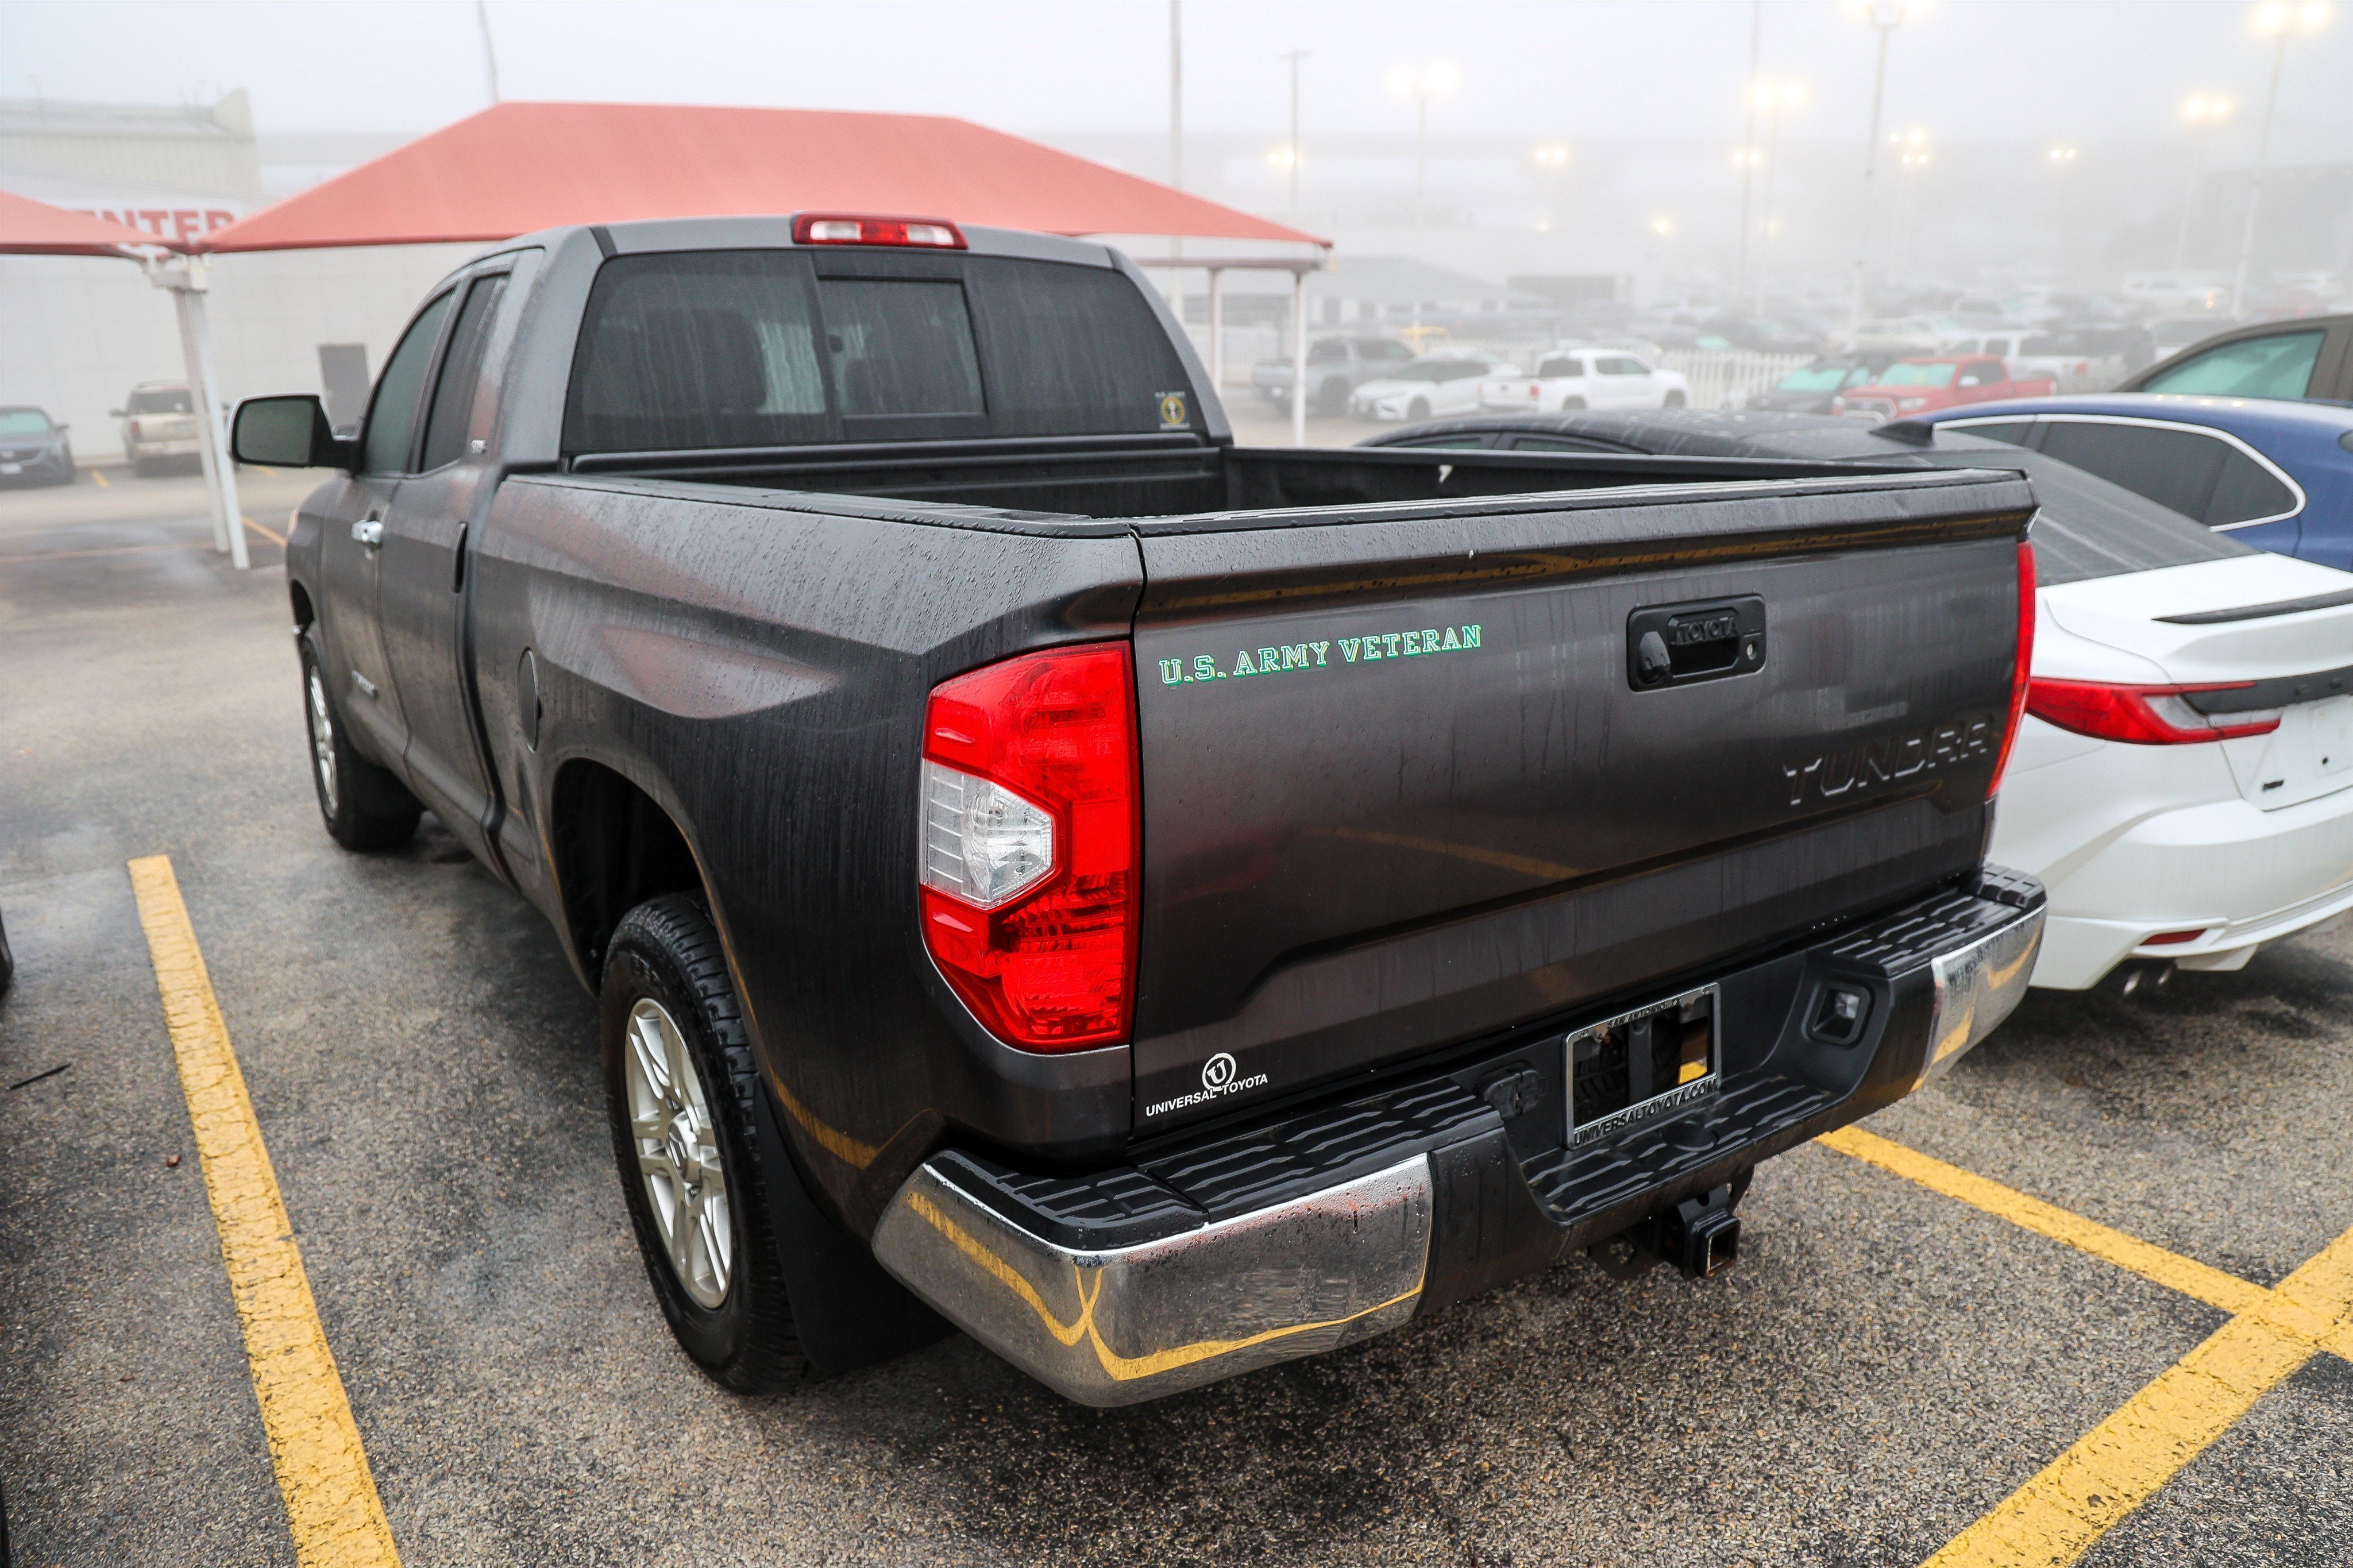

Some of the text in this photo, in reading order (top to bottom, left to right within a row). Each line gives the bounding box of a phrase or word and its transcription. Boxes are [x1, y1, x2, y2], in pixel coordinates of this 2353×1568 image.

[70, 209, 234, 242] NTE
[1159, 624, 1482, 686] U.S. ARMY VETERAN
[1678, 616, 1738, 643] TOYOTA
[1783, 712, 1995, 805] TUNDRA
[1145, 1073, 1268, 1117] UNIVERSAL TOYOTA
[1574, 1076, 1718, 1145] UNIVERSALTOYOTA.COM
